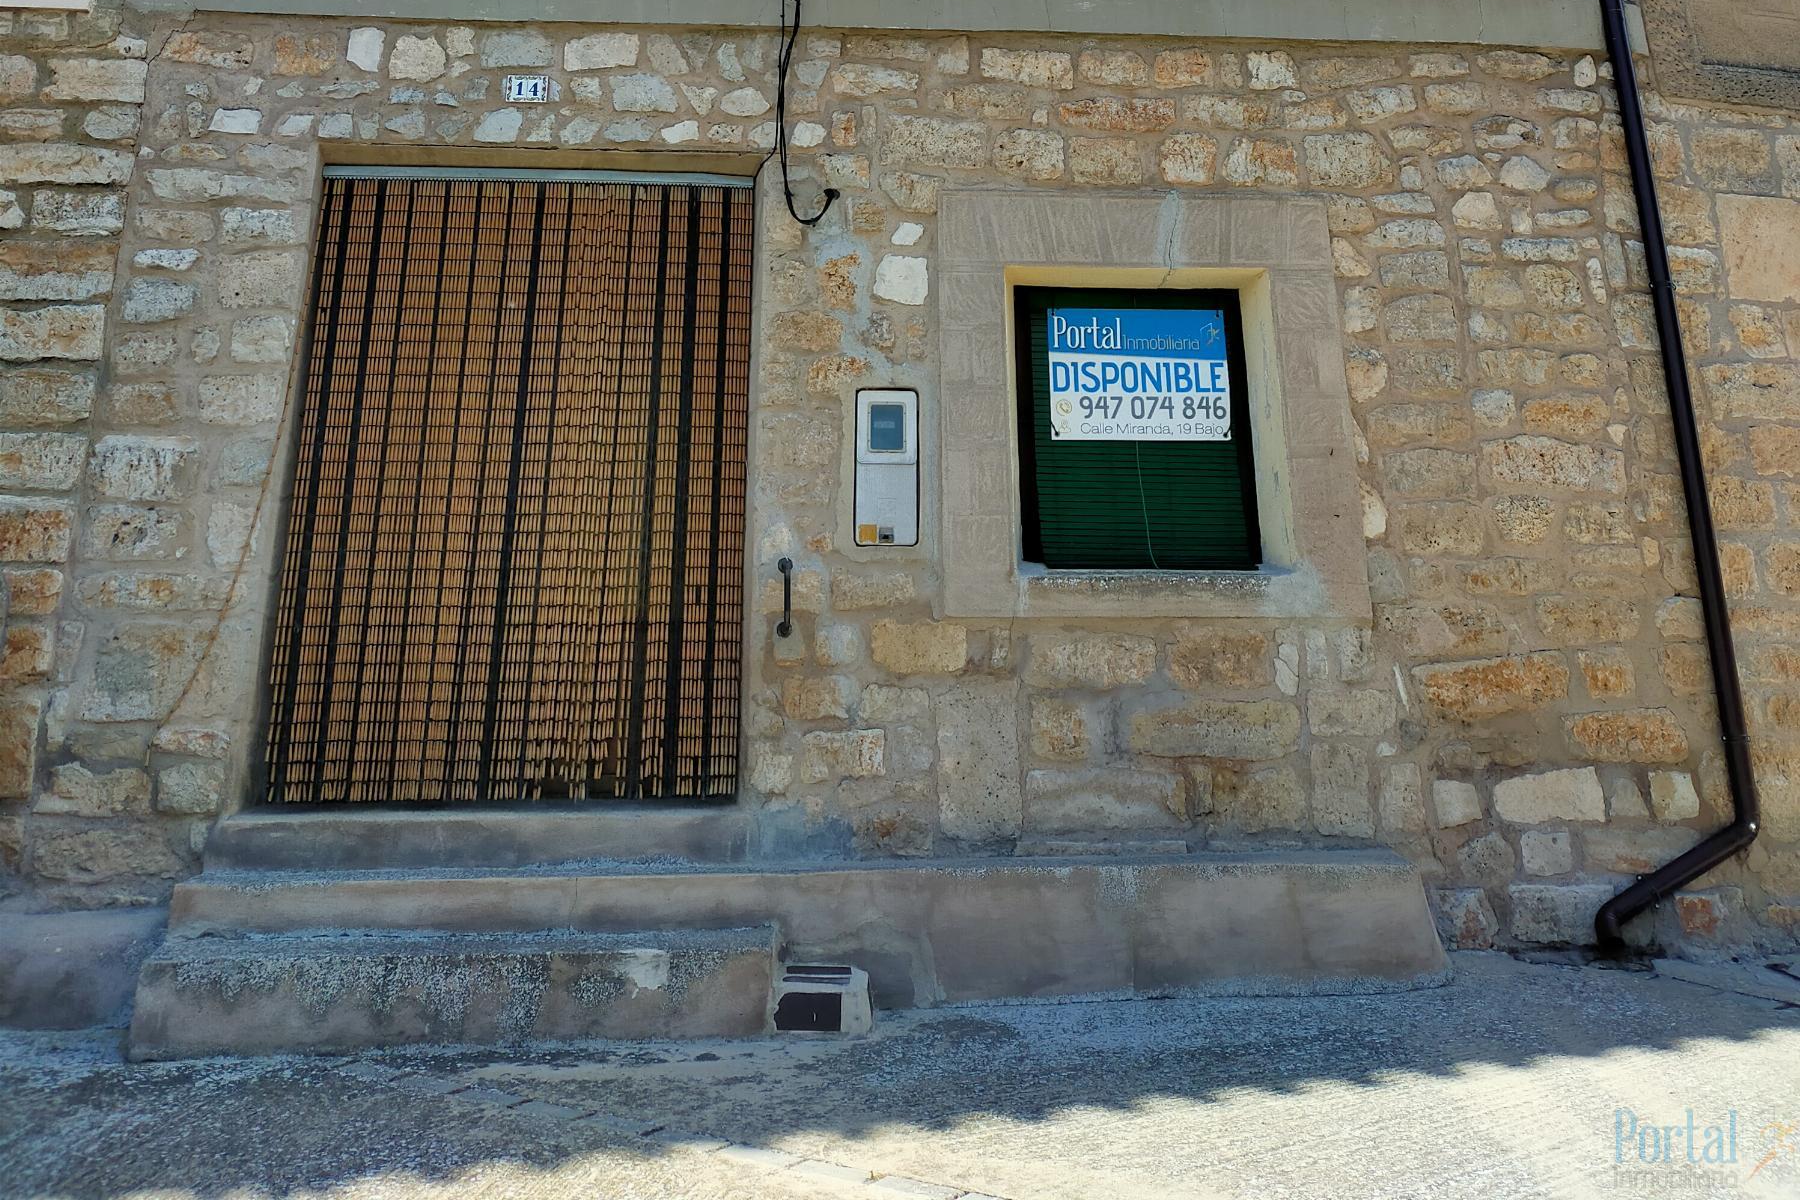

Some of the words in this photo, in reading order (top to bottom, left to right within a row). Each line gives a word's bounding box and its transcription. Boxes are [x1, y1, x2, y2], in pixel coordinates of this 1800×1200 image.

[516, 81, 539, 97] 14
[1052, 315, 1122, 349] Portal
[1122, 334, 1200, 350] Inmobiliaria
[1052, 361, 1226, 393] DISPONIBLE
[1079, 396, 1123, 419] 947
[1130, 396, 1174, 419] 074
[1182, 396, 1227, 419] 846
[1080, 422, 1113, 435] Calle
[1116, 423, 1174, 436] Miranda,
[1177, 423, 1192, 435] 19
[1195, 423, 1224, 437] Bajo
